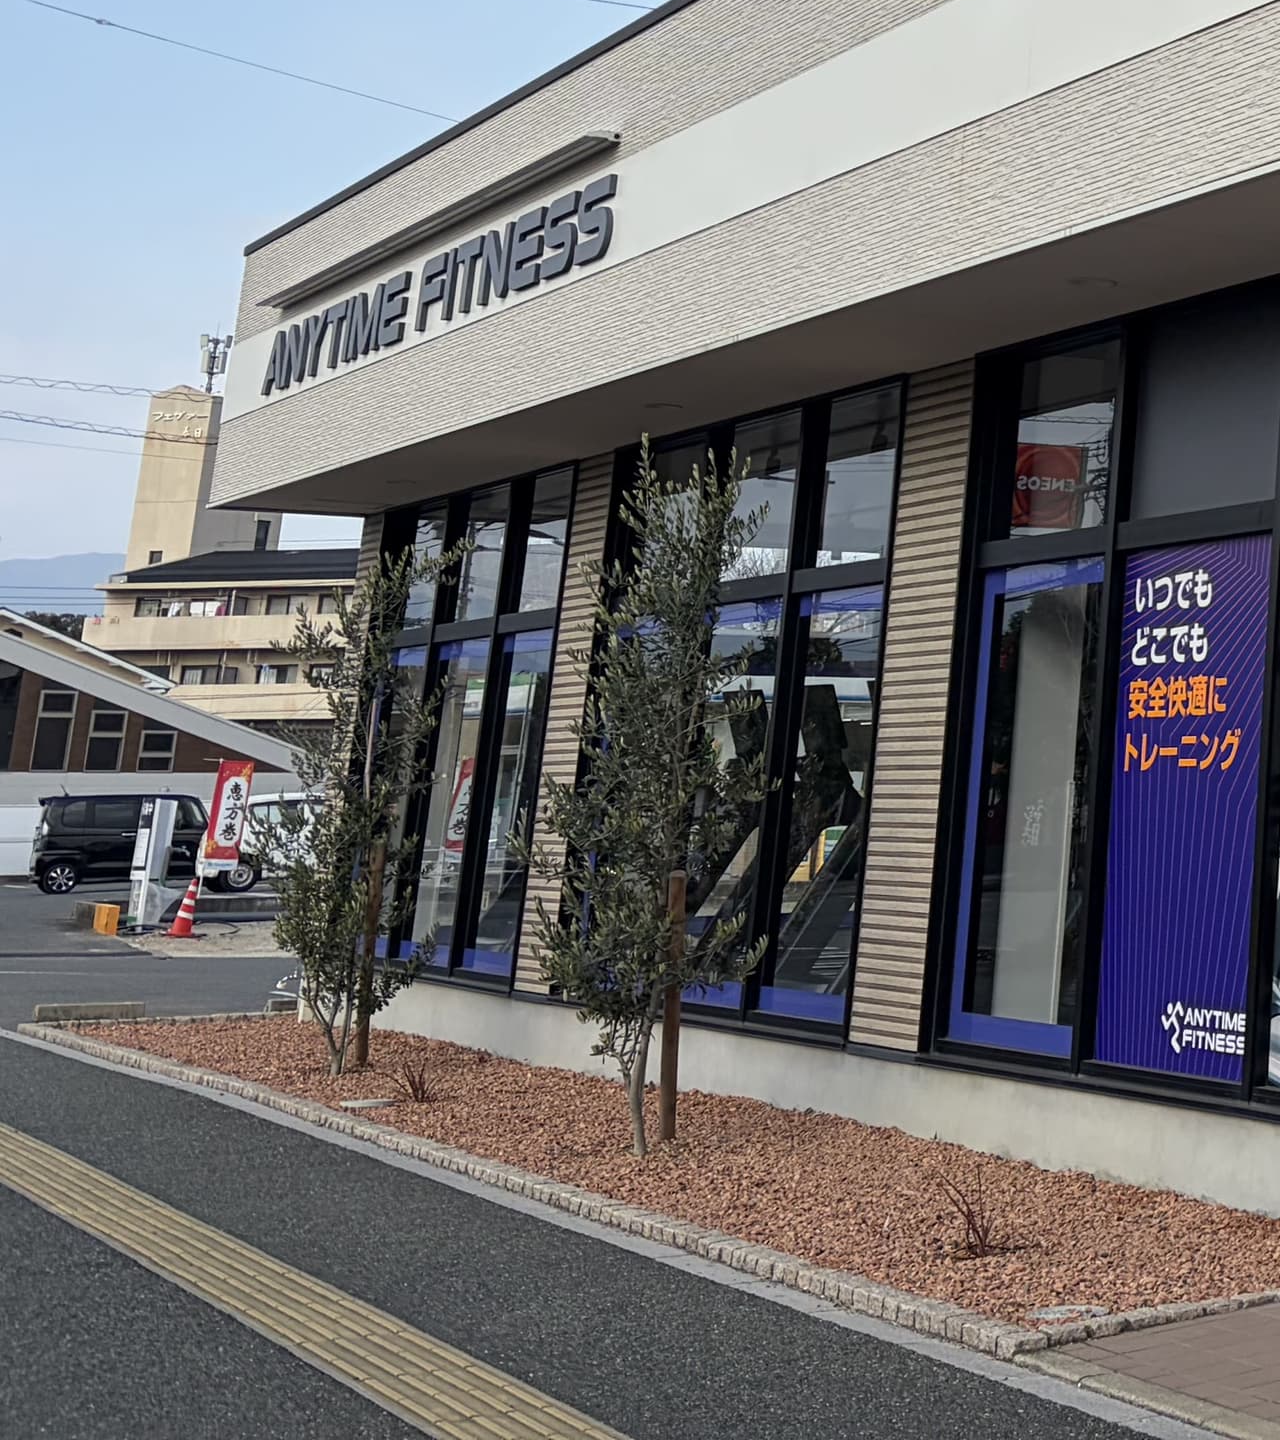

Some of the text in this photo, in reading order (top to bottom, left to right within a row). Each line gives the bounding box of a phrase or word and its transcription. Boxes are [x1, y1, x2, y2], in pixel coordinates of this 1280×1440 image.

[260, 173, 618, 396] ANYTIME FITNESS
[1135, 569, 1212, 613] いつでも
[1131, 623, 1208, 666] どこでも
[1128, 674, 1228, 720] 安全快適に
[1124, 728, 1241, 772] トレーニング
[218, 781, 246, 841] 恵方巻
[1184, 1007, 1246, 1032] ANYTIME
[1182, 1029, 1245, 1055] FITNESS
